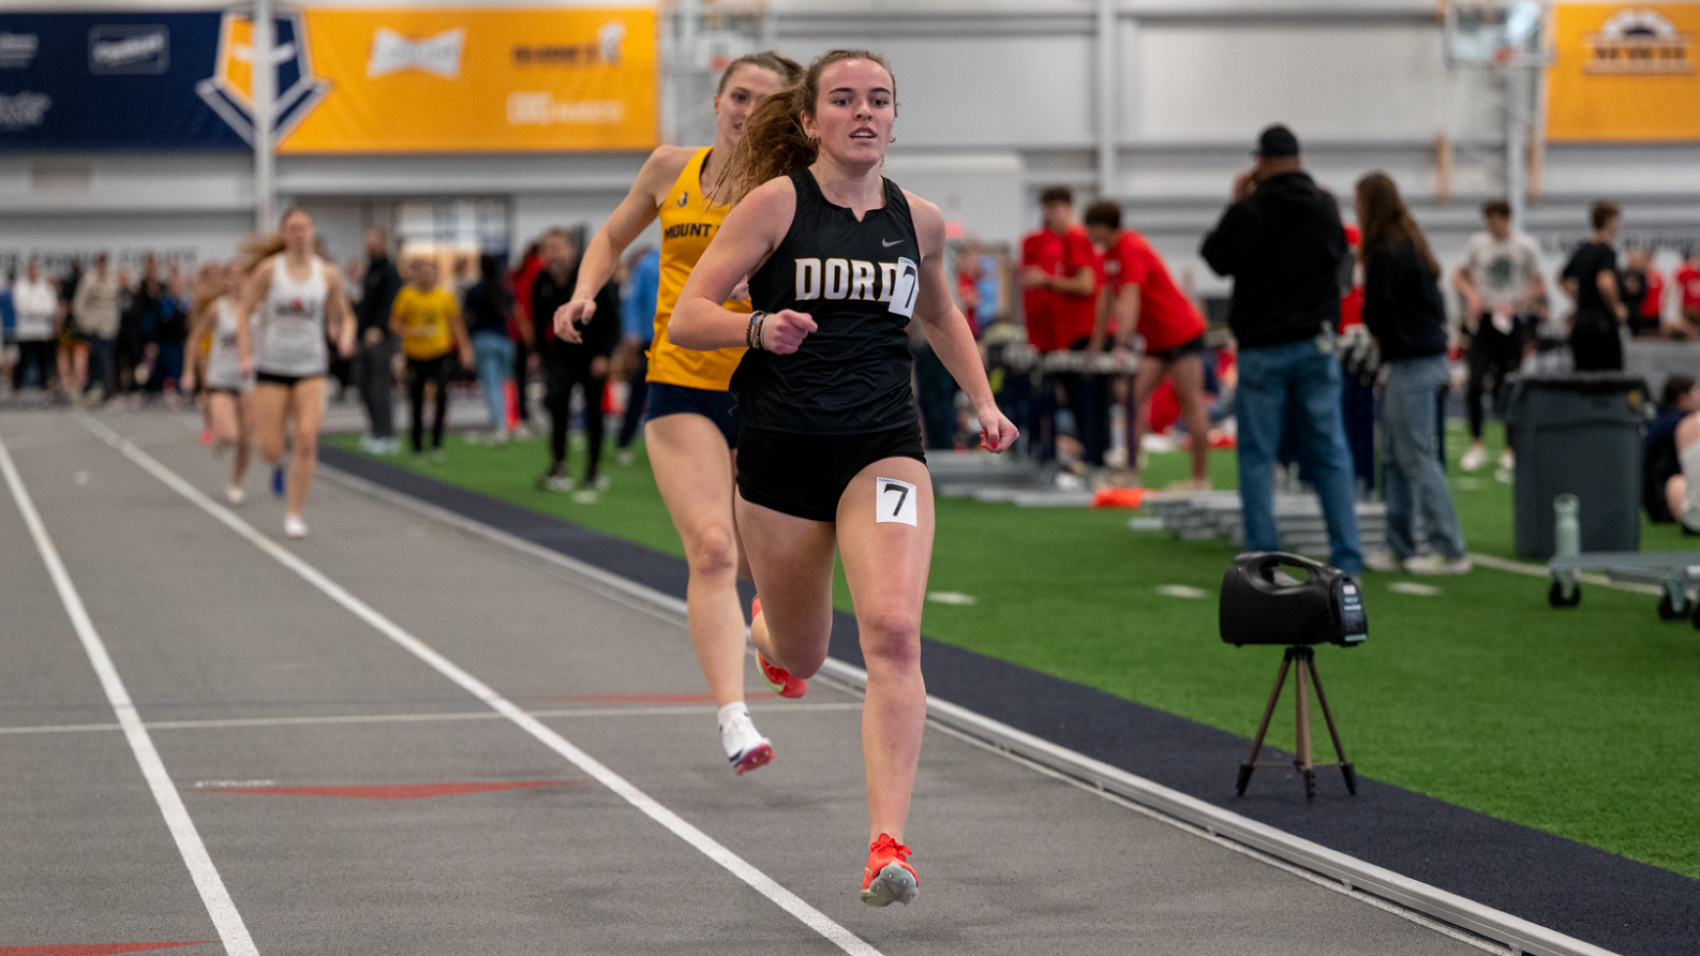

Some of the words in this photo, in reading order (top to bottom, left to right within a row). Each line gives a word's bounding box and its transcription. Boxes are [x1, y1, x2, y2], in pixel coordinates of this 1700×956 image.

[664, 223, 712, 241] MOUNT
[902, 265, 917, 309] 7
[883, 483, 909, 517] 7
